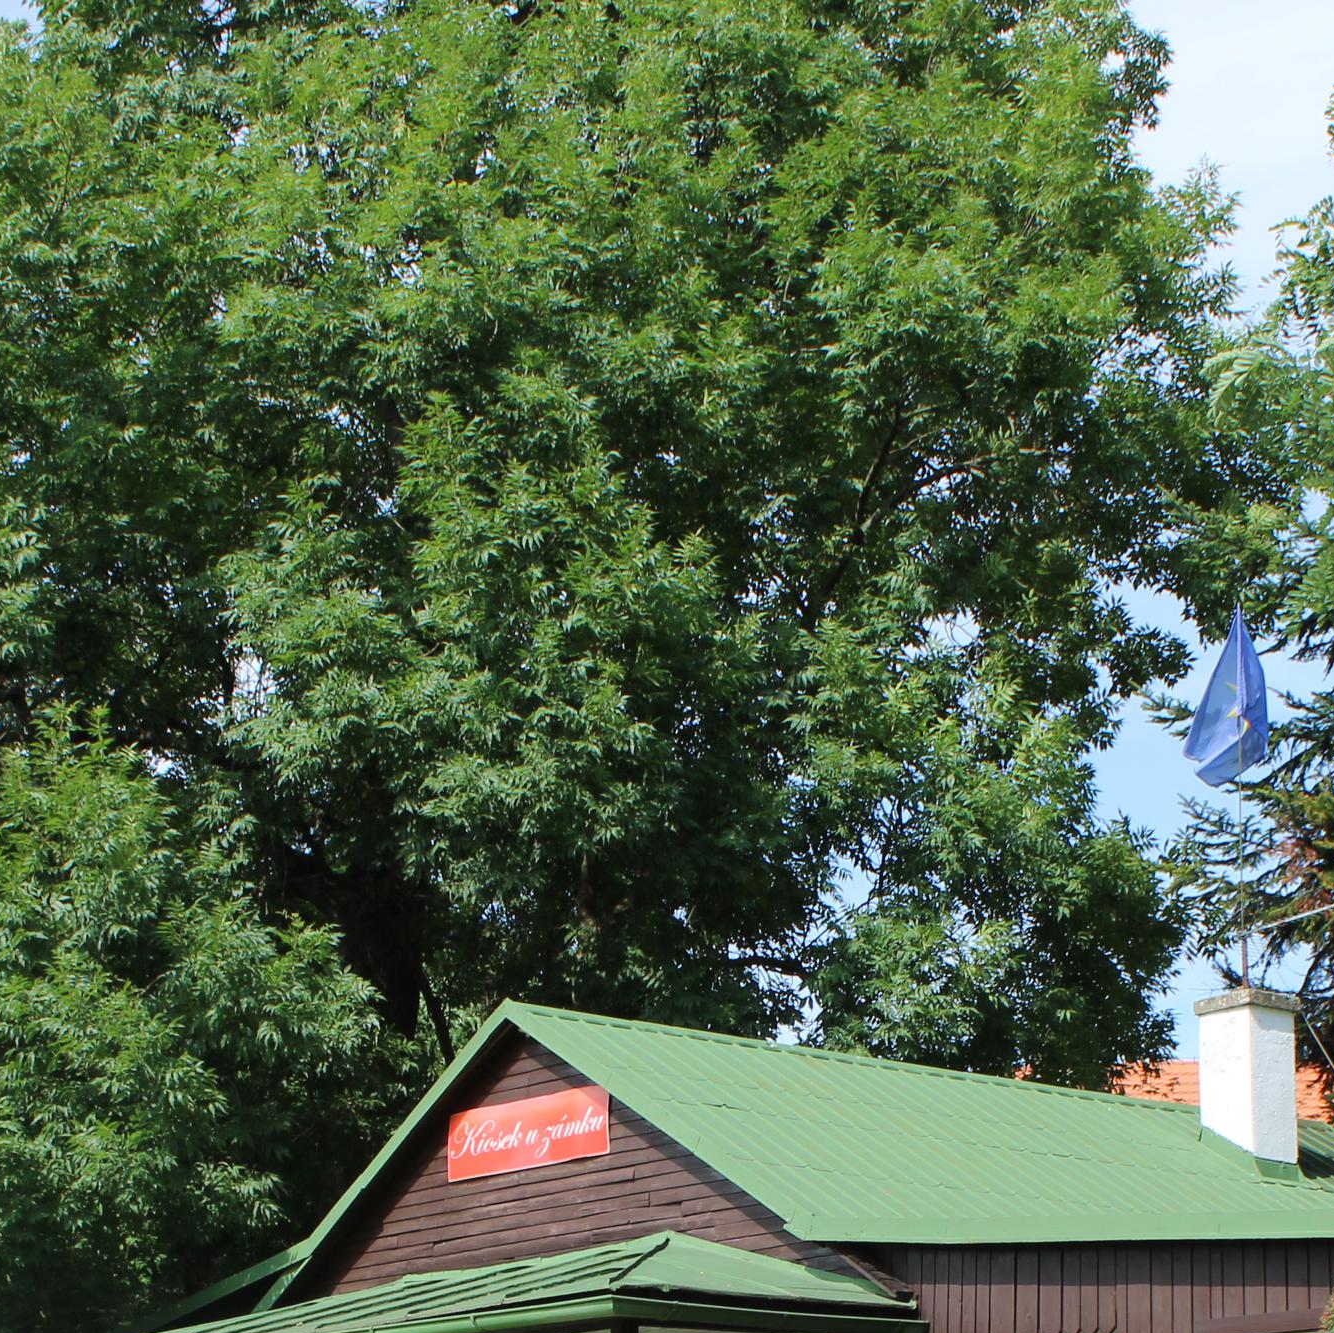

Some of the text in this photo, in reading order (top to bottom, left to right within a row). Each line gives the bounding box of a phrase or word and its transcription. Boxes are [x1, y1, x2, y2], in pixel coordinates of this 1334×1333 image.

[451, 1106, 605, 1159] Kiosek u zámku
